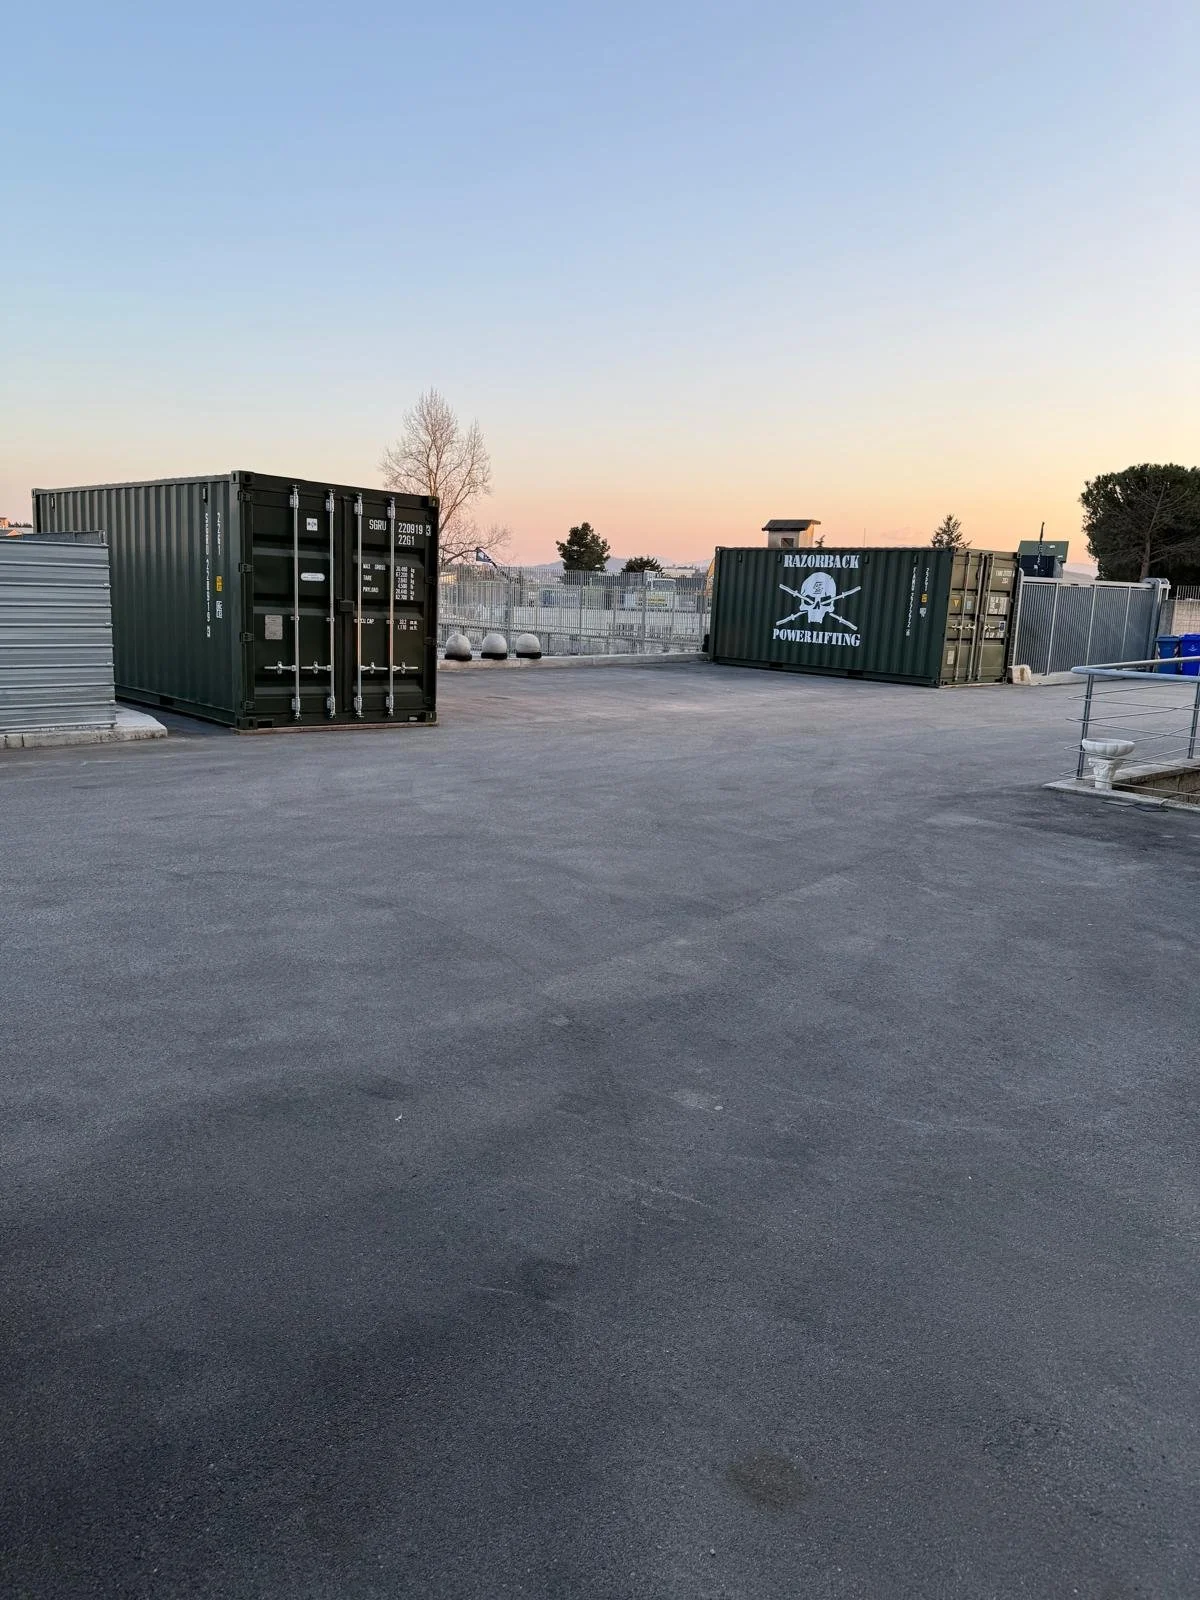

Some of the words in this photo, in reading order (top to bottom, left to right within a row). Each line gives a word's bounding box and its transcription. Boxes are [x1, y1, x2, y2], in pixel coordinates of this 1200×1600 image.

[368, 519, 387, 532] SGRU
[398, 522, 424, 535] 220919
[426, 524, 432, 537] 3
[398, 534, 415, 546] 22G1
[784, 554, 860, 568] RAZORBACK
[772, 628, 861, 647] POWERLIFTING
